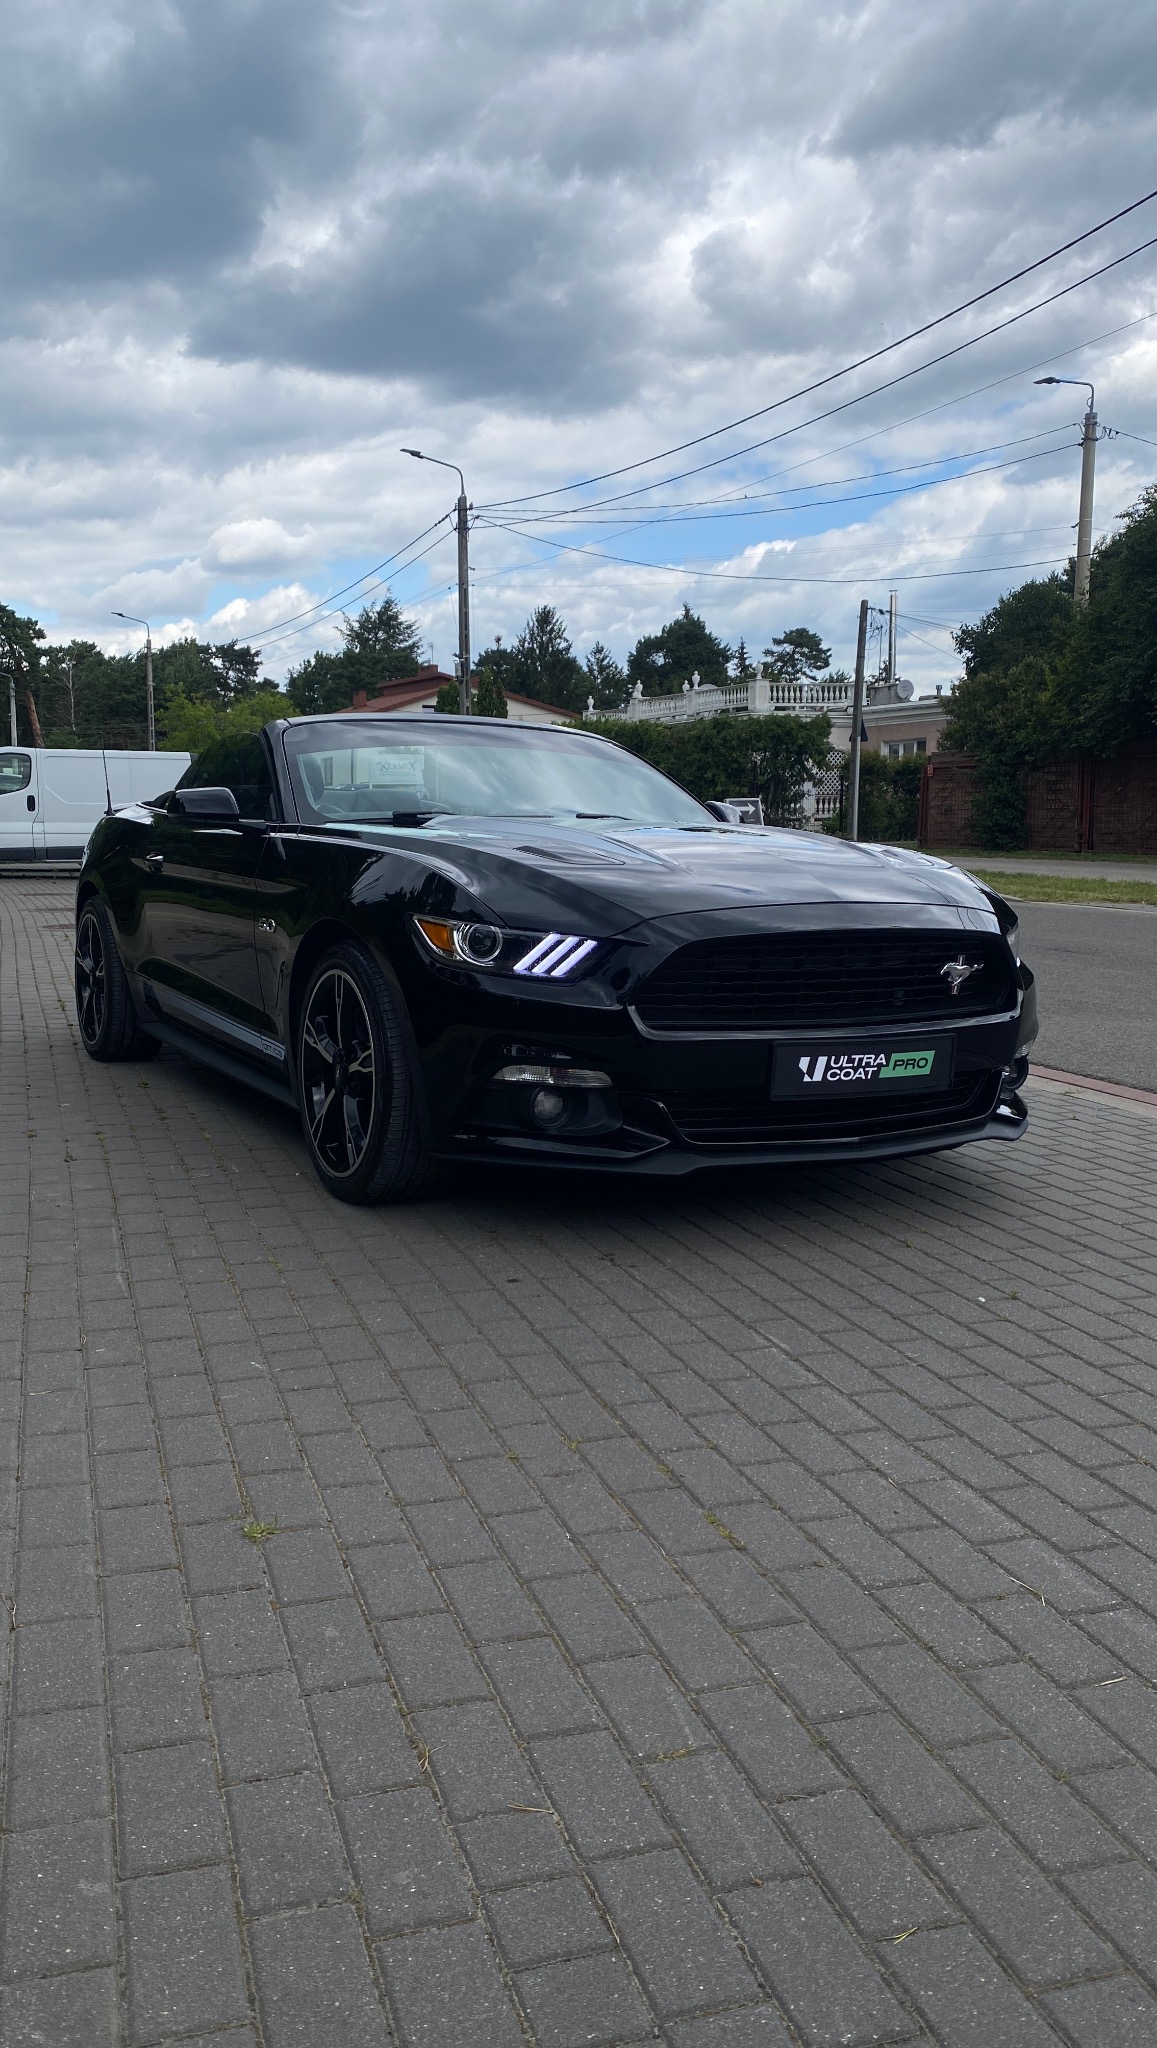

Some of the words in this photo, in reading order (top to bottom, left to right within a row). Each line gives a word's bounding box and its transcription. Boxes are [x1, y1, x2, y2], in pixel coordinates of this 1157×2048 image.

[830, 1053, 887, 1068] ULTRA
[892, 1057, 929, 1071] PRO
[826, 1067, 878, 1081] COAT
